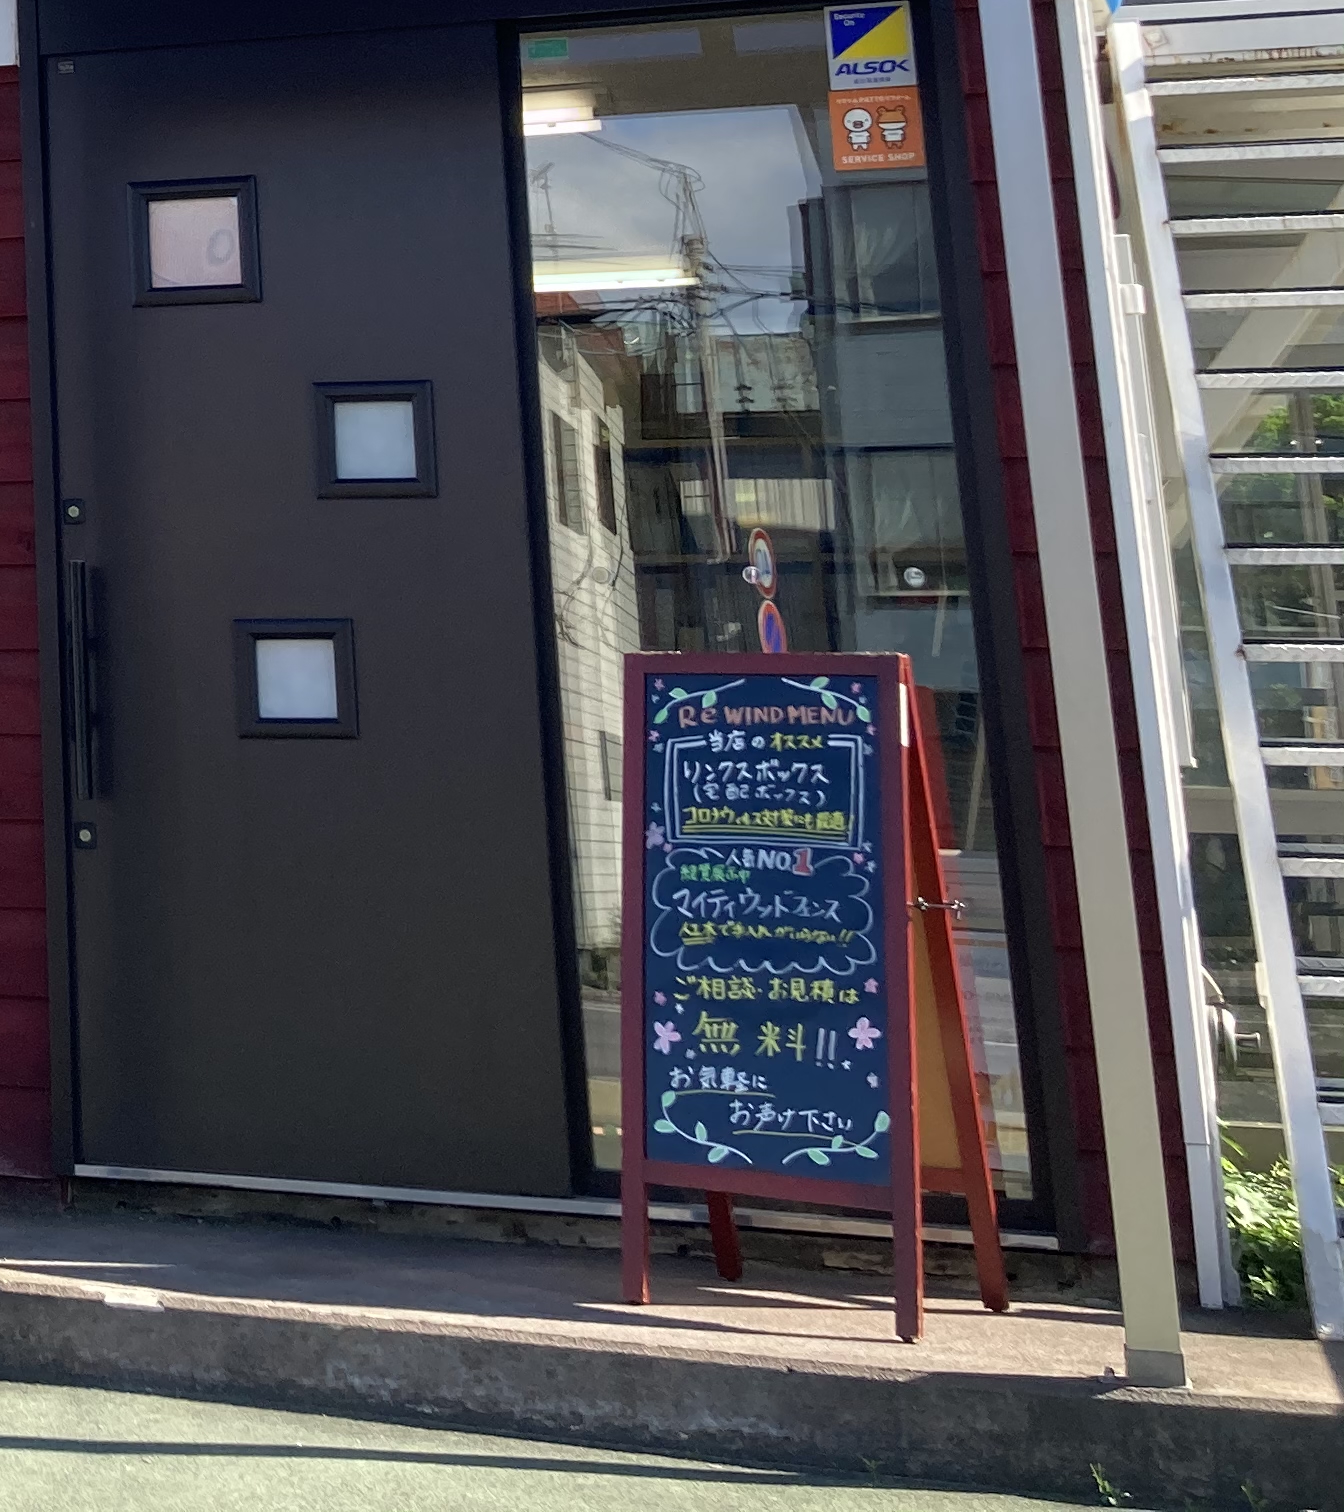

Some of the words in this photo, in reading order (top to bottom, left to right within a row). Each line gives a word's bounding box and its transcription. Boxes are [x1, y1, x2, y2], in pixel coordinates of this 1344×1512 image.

[834, 59, 911, 77] ALSOK
[841, 154, 885, 164] SERVICE
[887, 152, 915, 161] SHOP
[724, 705, 784, 726] WIND
[787, 705, 855, 726] MENU
[683, 758, 830, 785] リンクスボックス
[668, 1064, 768, 1093] お気軽に
